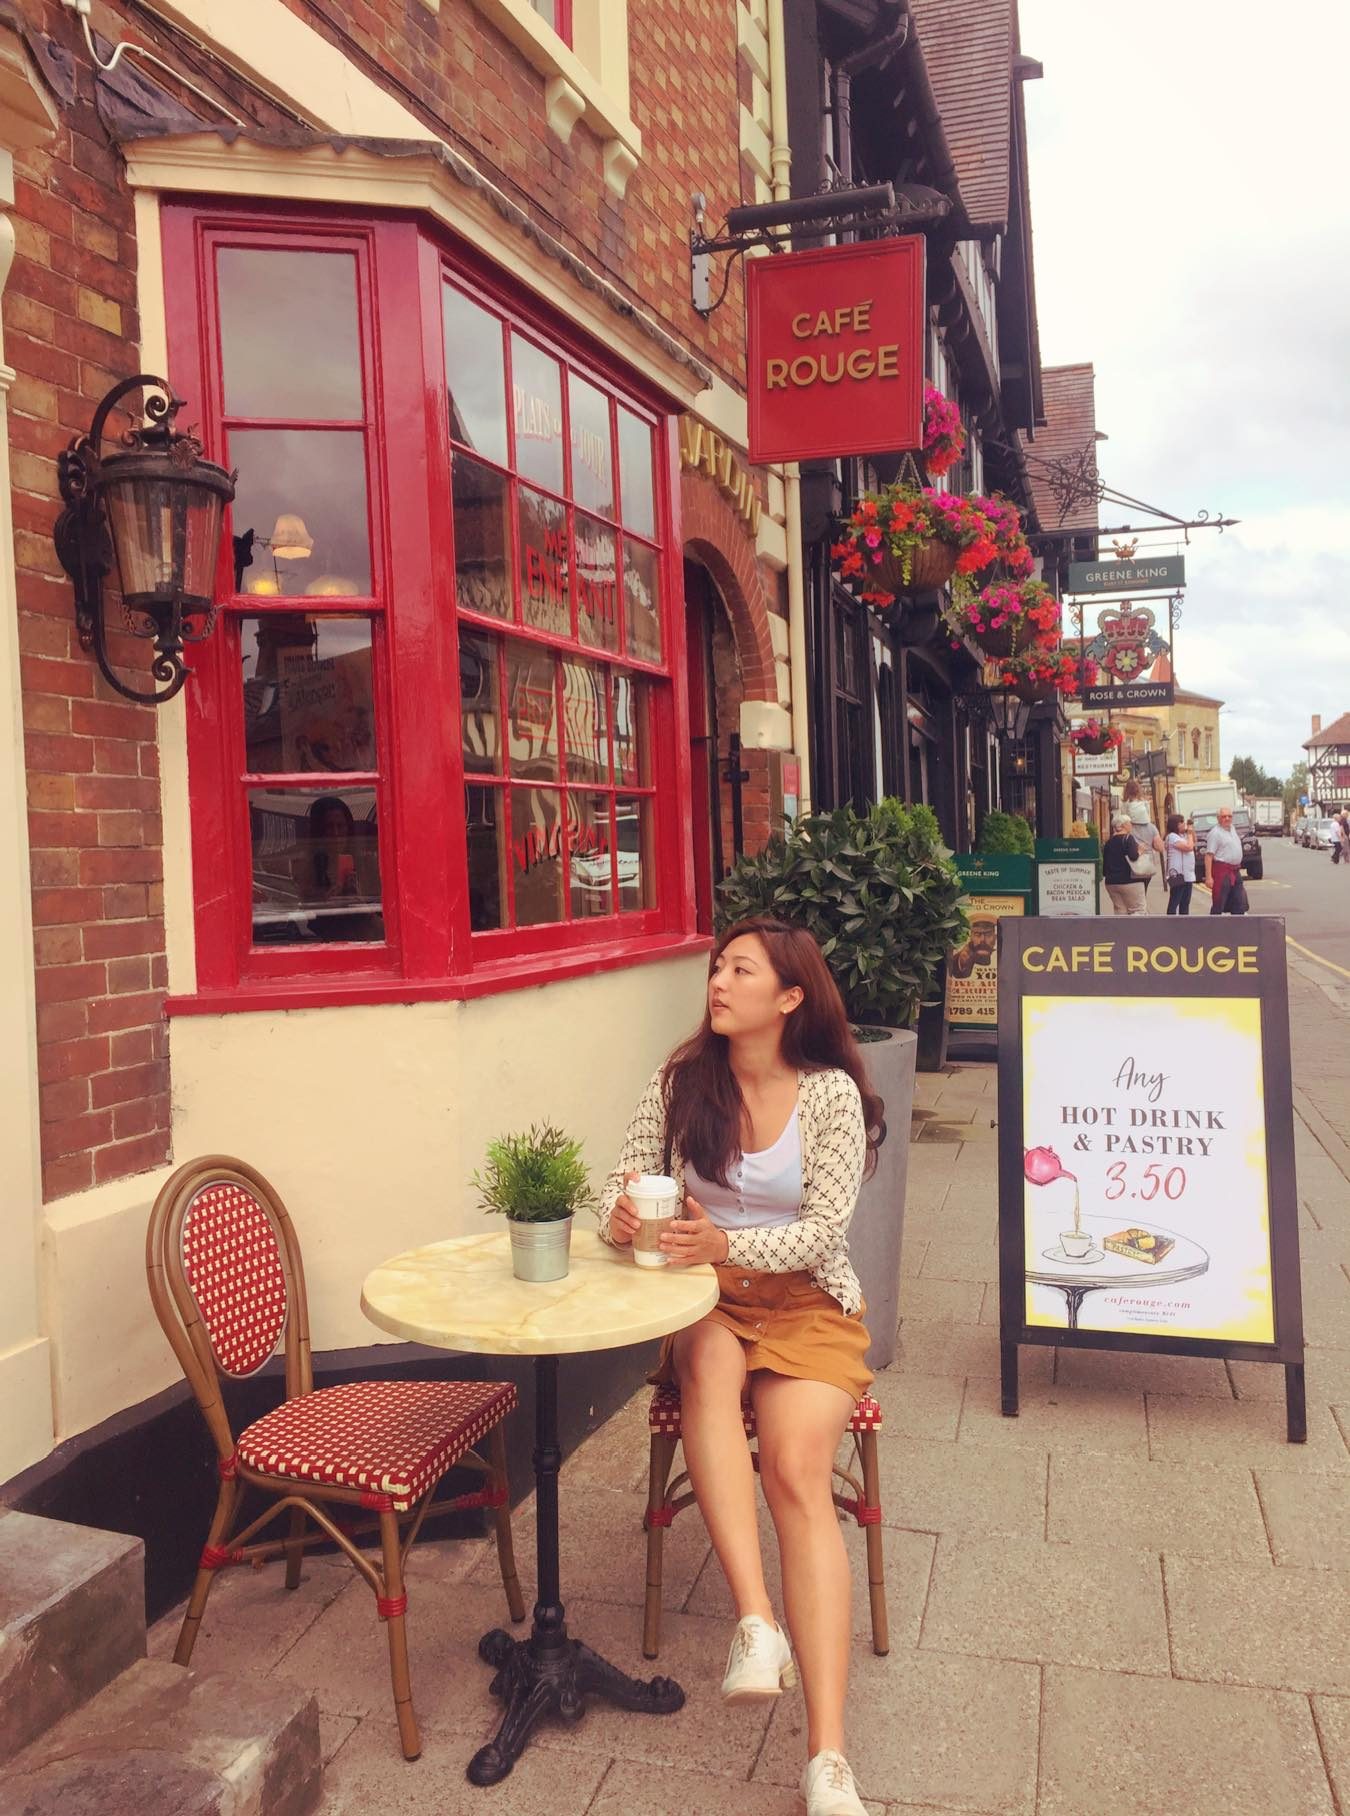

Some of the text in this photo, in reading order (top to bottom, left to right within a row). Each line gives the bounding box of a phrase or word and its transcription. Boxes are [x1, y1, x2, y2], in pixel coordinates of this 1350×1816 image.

[792, 300, 873, 338] CAFÉ
[767, 344, 900, 389] ROUGE
[1086, 567, 1168, 582] GREENE KING
[1089, 688, 1167, 701] ROSE & CROWN
[1022, 942, 1260, 974] CAFÉ ROUGE
[976, 972, 997, 980] YO
[1112, 1056, 1171, 1103] Any
[1060, 1105, 1227, 1130] HOT DRINK
[1072, 1132, 1213, 1157] & PASTRY
[1105, 1160, 1187, 1201] 3.50
[1104, 1296, 1191, 1310] caferouge.com
